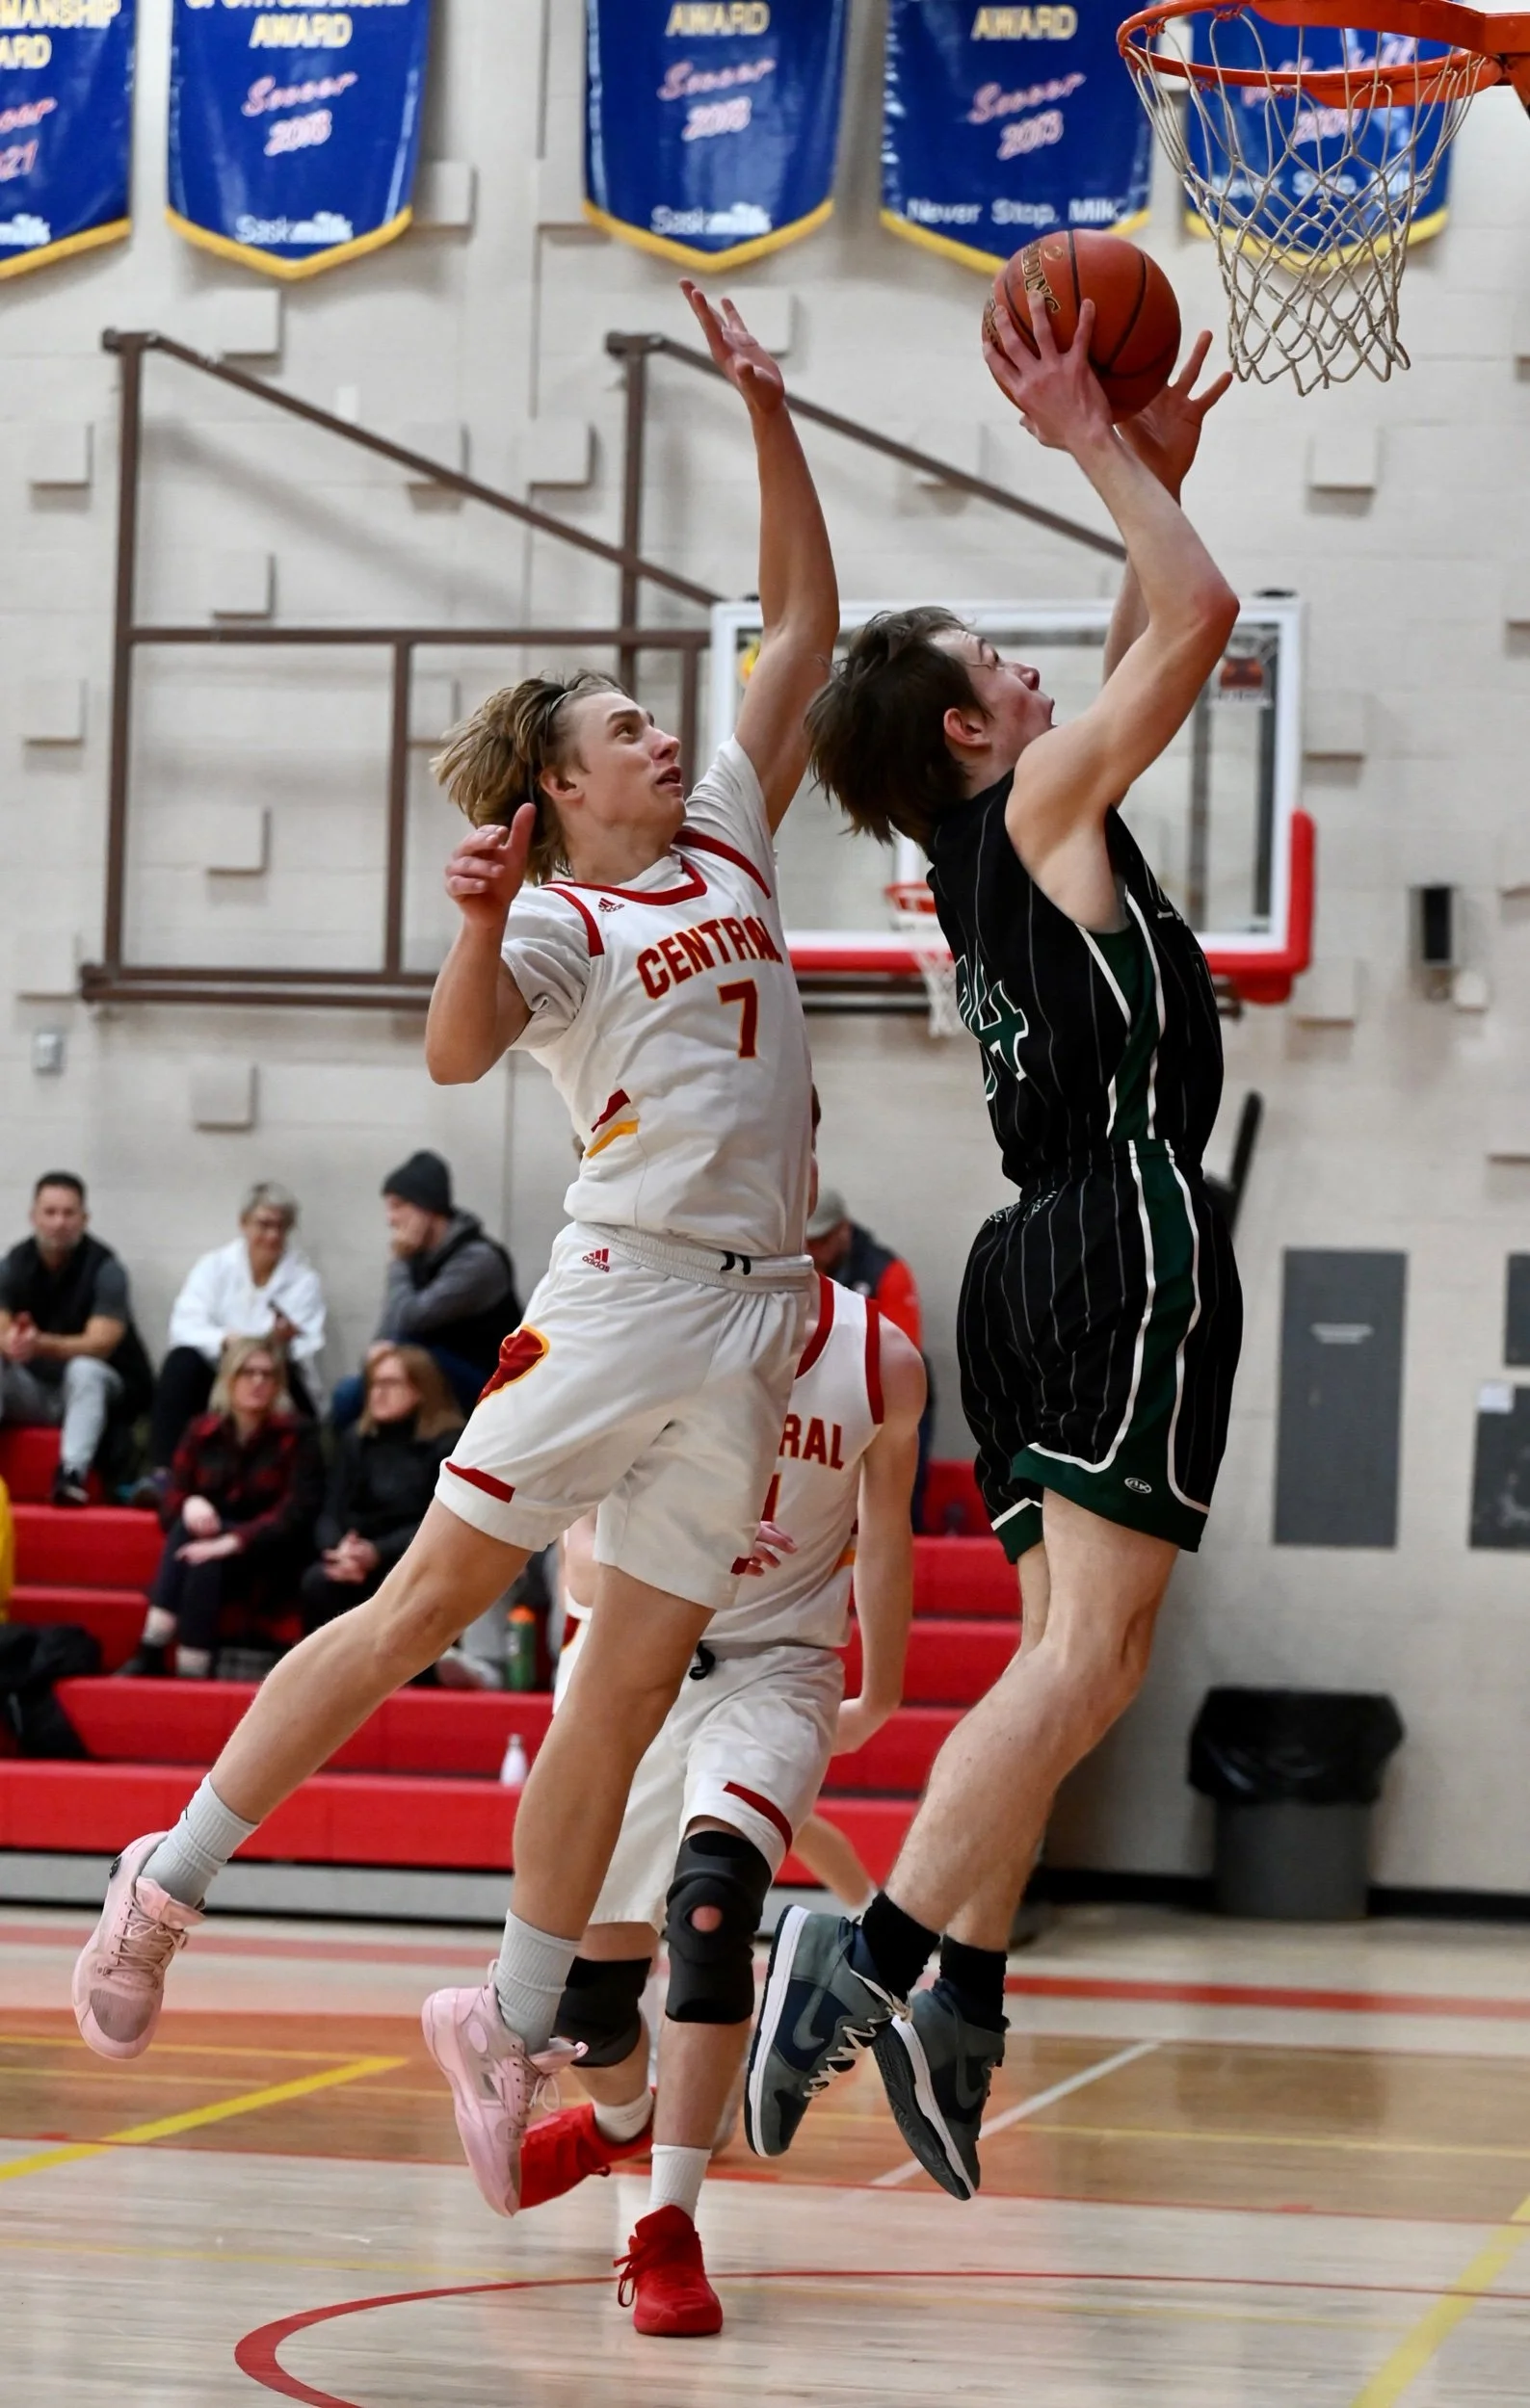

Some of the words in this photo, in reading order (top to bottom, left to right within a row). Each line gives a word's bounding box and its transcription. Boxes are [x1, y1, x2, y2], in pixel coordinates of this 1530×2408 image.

[249, 13, 353, 48] AWARD
[665, 2, 770, 37] AWARD
[970, 5, 1078, 40] AWARD
[907, 198, 983, 224] Never
[717, 979, 759, 1060] 7
[582, 1255, 611, 1273] adidas
